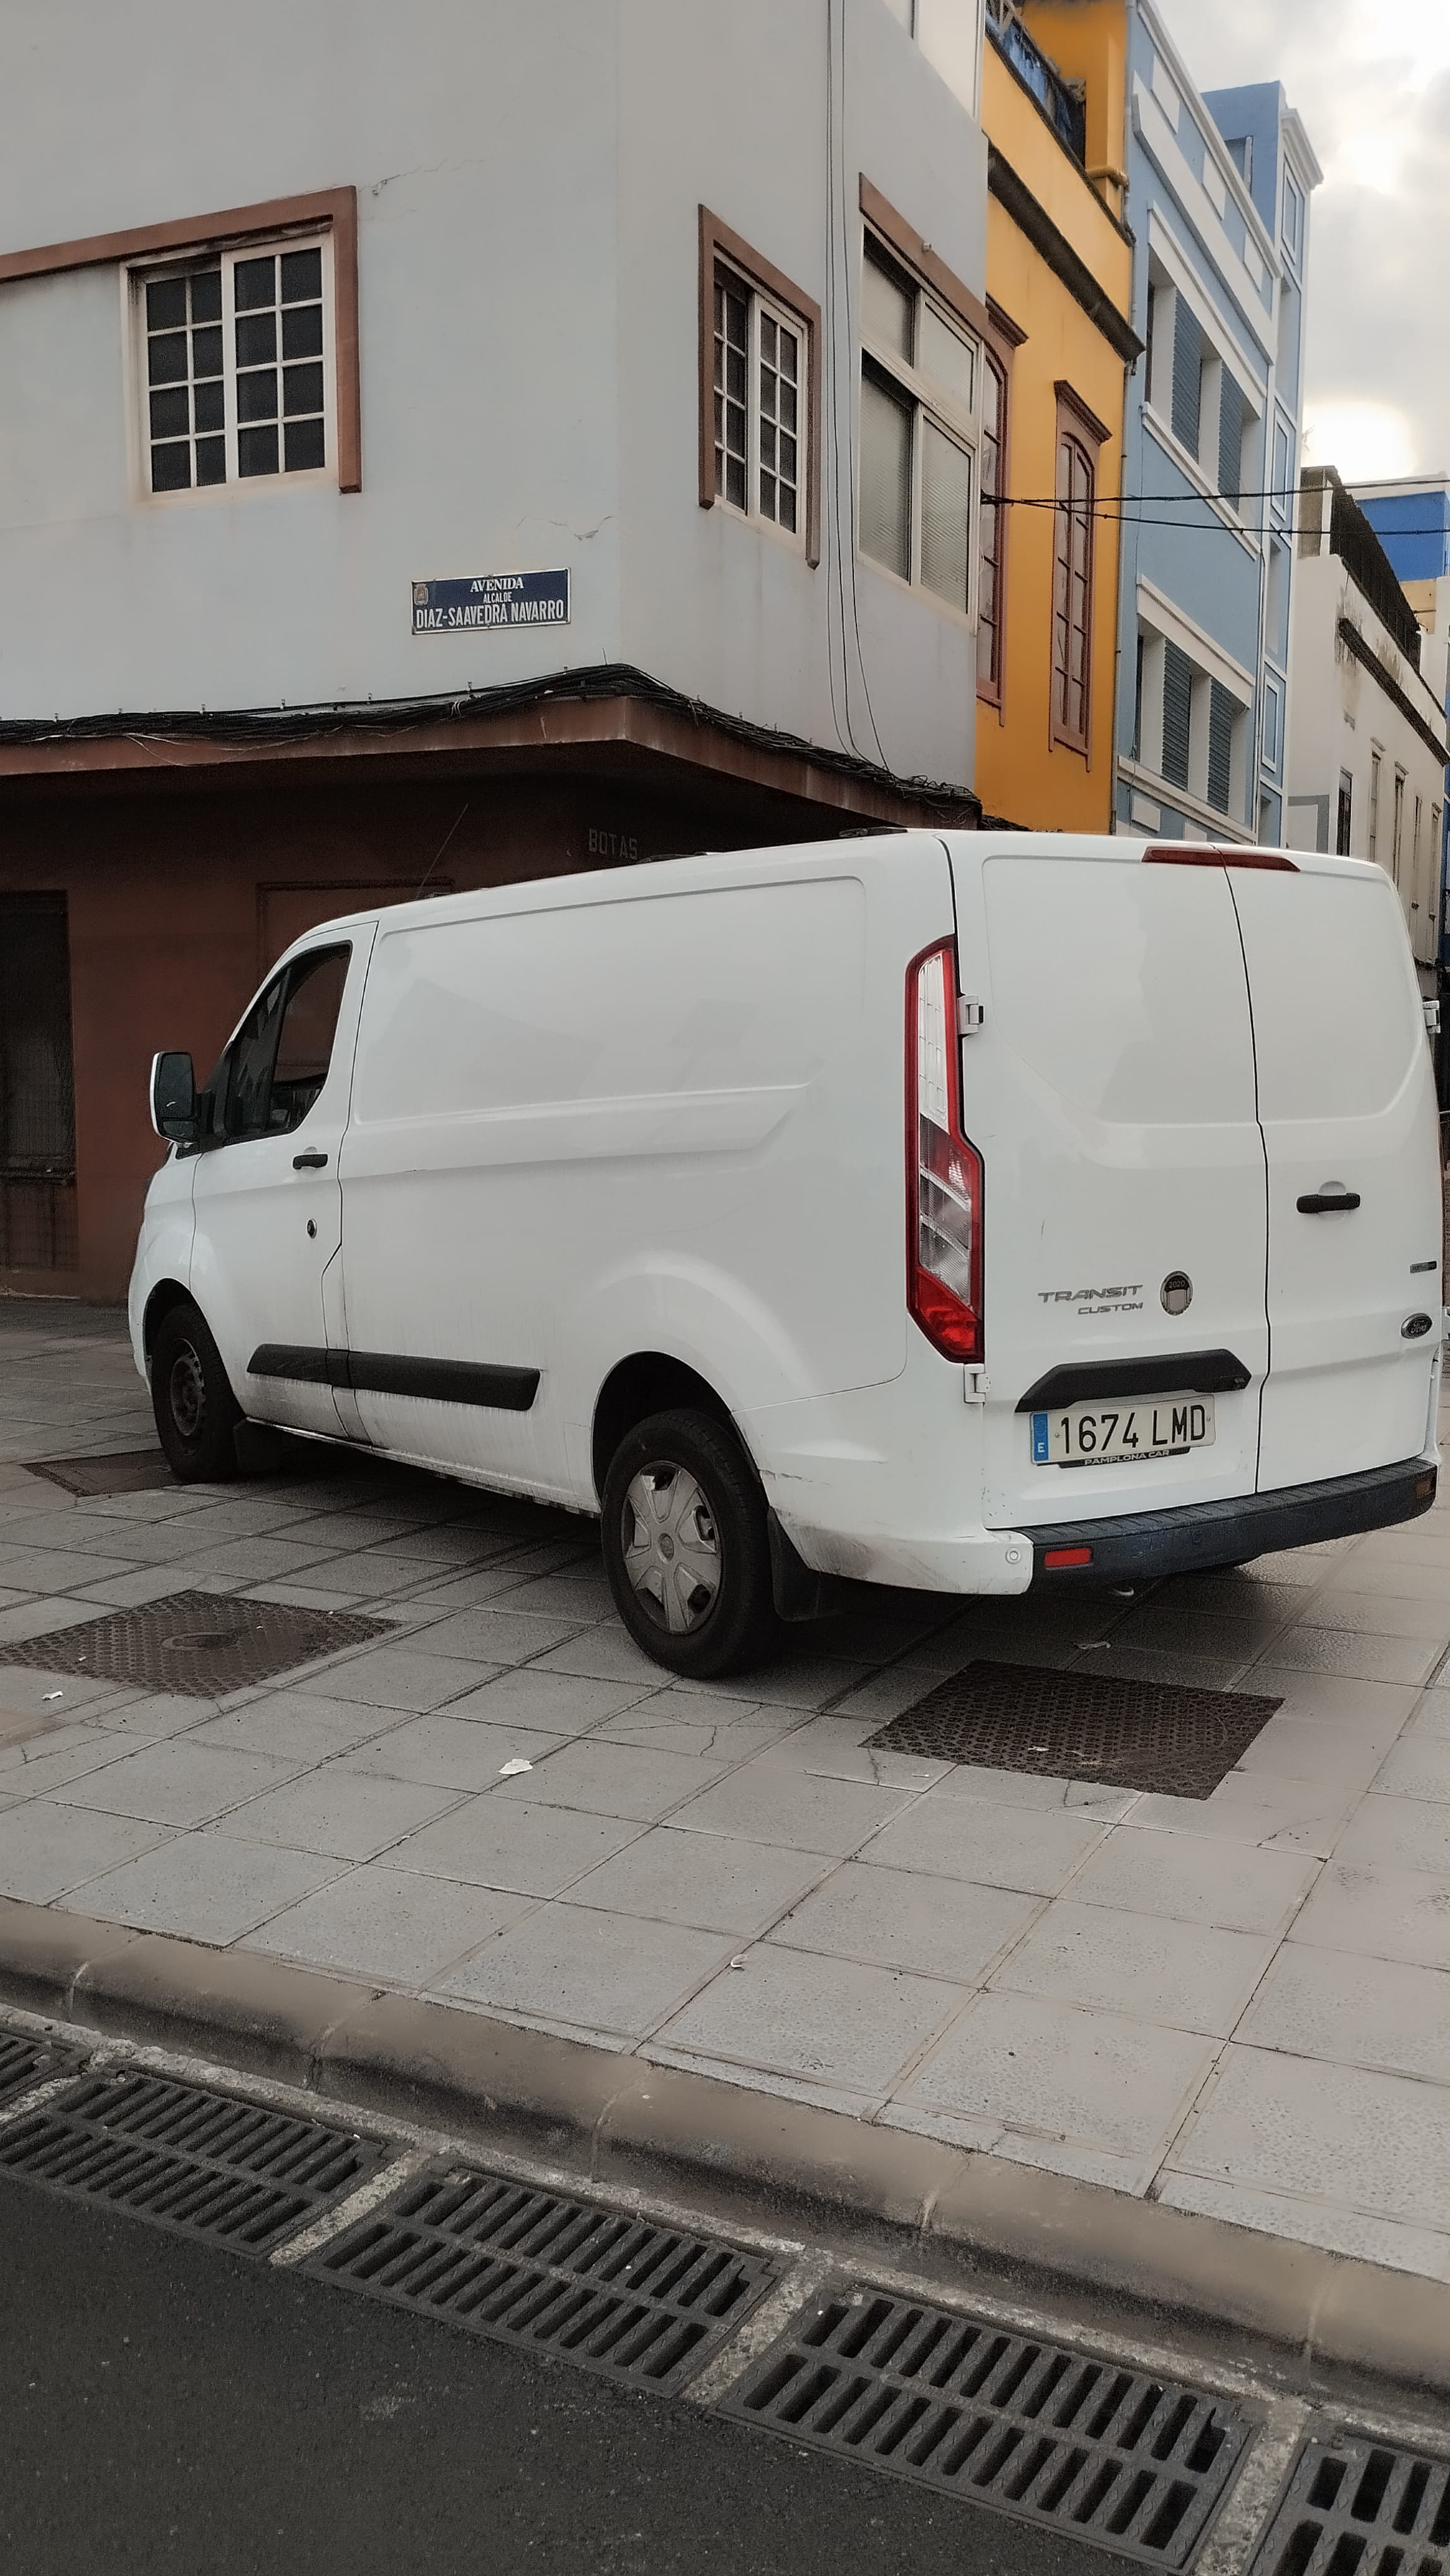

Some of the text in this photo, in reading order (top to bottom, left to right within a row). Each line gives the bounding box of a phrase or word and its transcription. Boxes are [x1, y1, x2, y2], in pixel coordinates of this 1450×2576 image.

[470, 577, 524, 593] AVENIDA
[482, 592, 512, 604] ALCALDE
[416, 599, 564, 629] DIAZ-SAAVEDRA NAVARRO
[589, 828, 637, 860] BOTAS
[1168, 1280, 1185, 1289] 2020
[1038, 1284, 1143, 1303] TRANSIT
[1077, 1302, 1144, 1315] CUSTOM
[1061, 1404, 1206, 1454] 1674 LMD
[1038, 1443, 1045, 1453] E
[1084, 1450, 1169, 1465] PAMPLONA CAR
